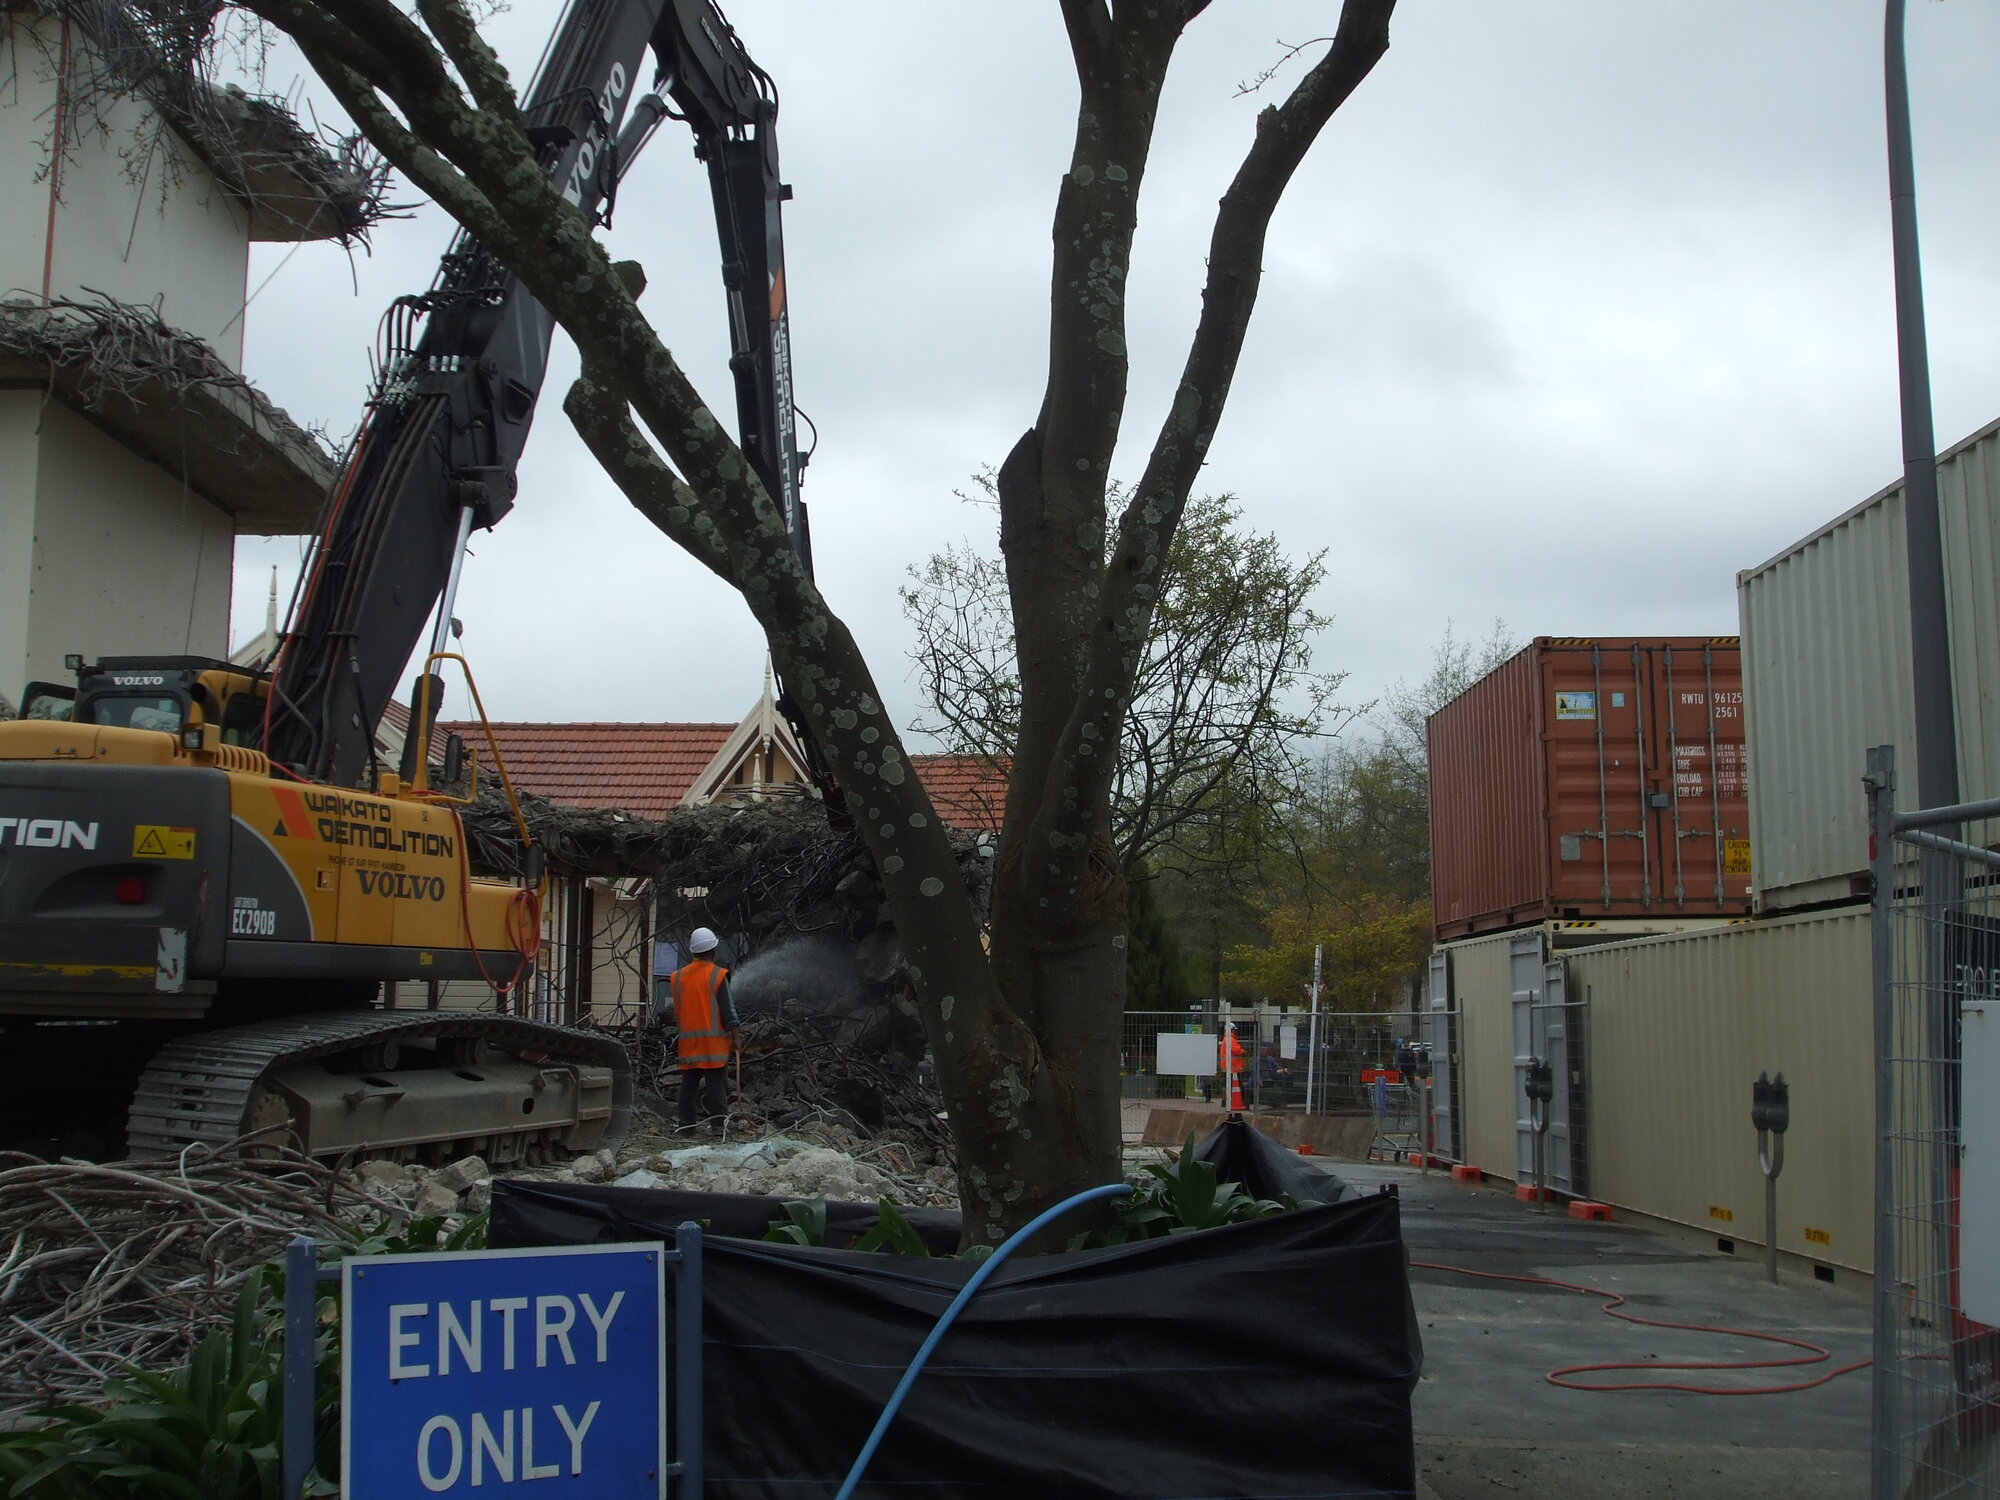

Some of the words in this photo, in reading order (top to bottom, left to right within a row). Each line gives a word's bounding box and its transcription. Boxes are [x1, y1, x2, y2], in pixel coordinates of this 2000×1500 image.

[780, 311, 794, 435] WAIKATO
[774, 329, 795, 535] DEMOLITION
[112, 676, 164, 686] VOLVO
[1682, 693, 1704, 705] RWTU
[1716, 706, 1737, 718] 25G1
[1676, 772, 1702, 784] PAYLOAD
[1677, 759, 1691, 770] TARE
[304, 791, 392, 822] WAIKATO
[318, 817, 454, 858] DEMOLITION
[356, 868, 446, 902] VOLVO
[232, 908, 276, 935] EC290B
[389, 1290, 626, 1381] ENTRY
[416, 1400, 602, 1493] ONLY
